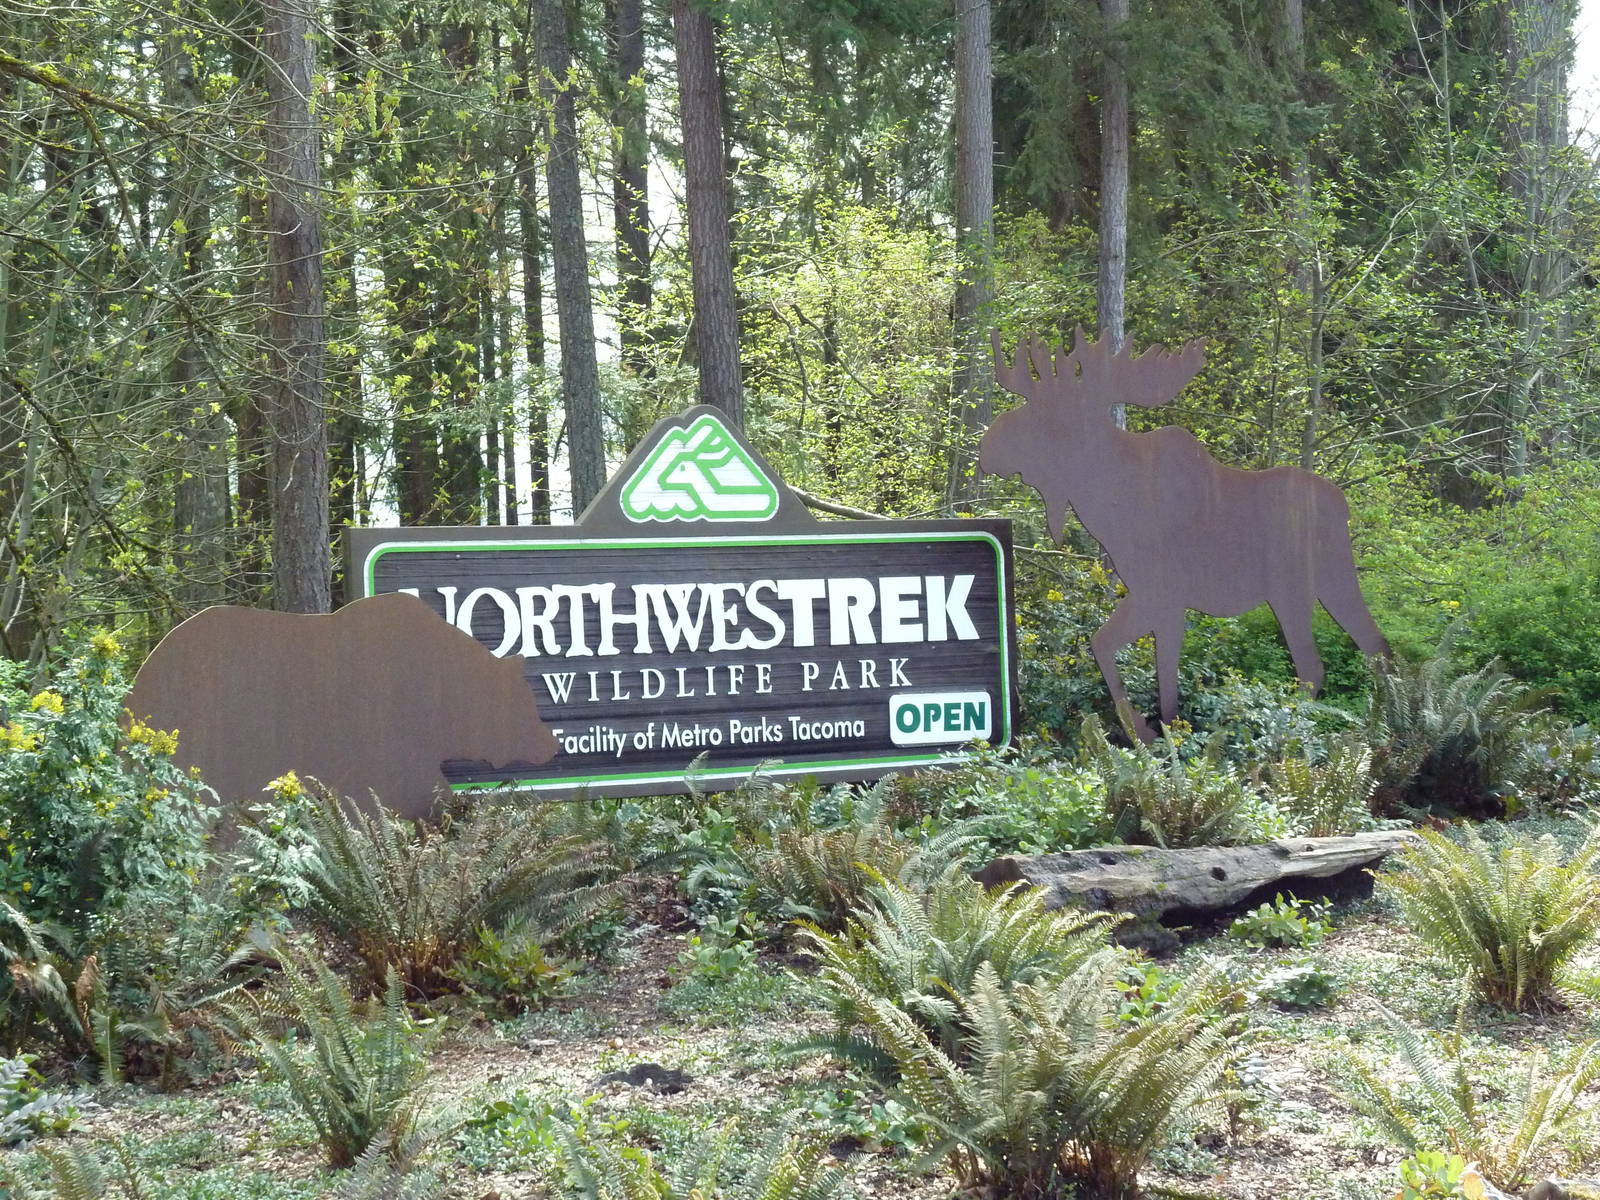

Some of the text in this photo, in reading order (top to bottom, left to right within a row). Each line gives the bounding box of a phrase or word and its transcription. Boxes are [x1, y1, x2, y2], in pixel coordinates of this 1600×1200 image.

[398, 574, 980, 659] ORTHWESTREK
[542, 658, 912, 704] WILDLIFE PARK
[632, 723, 655, 750] of
[660, 718, 723, 748] Metro
[729, 716, 783, 744] Parks
[788, 716, 865, 740] Tacoma
[896, 702, 986, 733] OPEN
